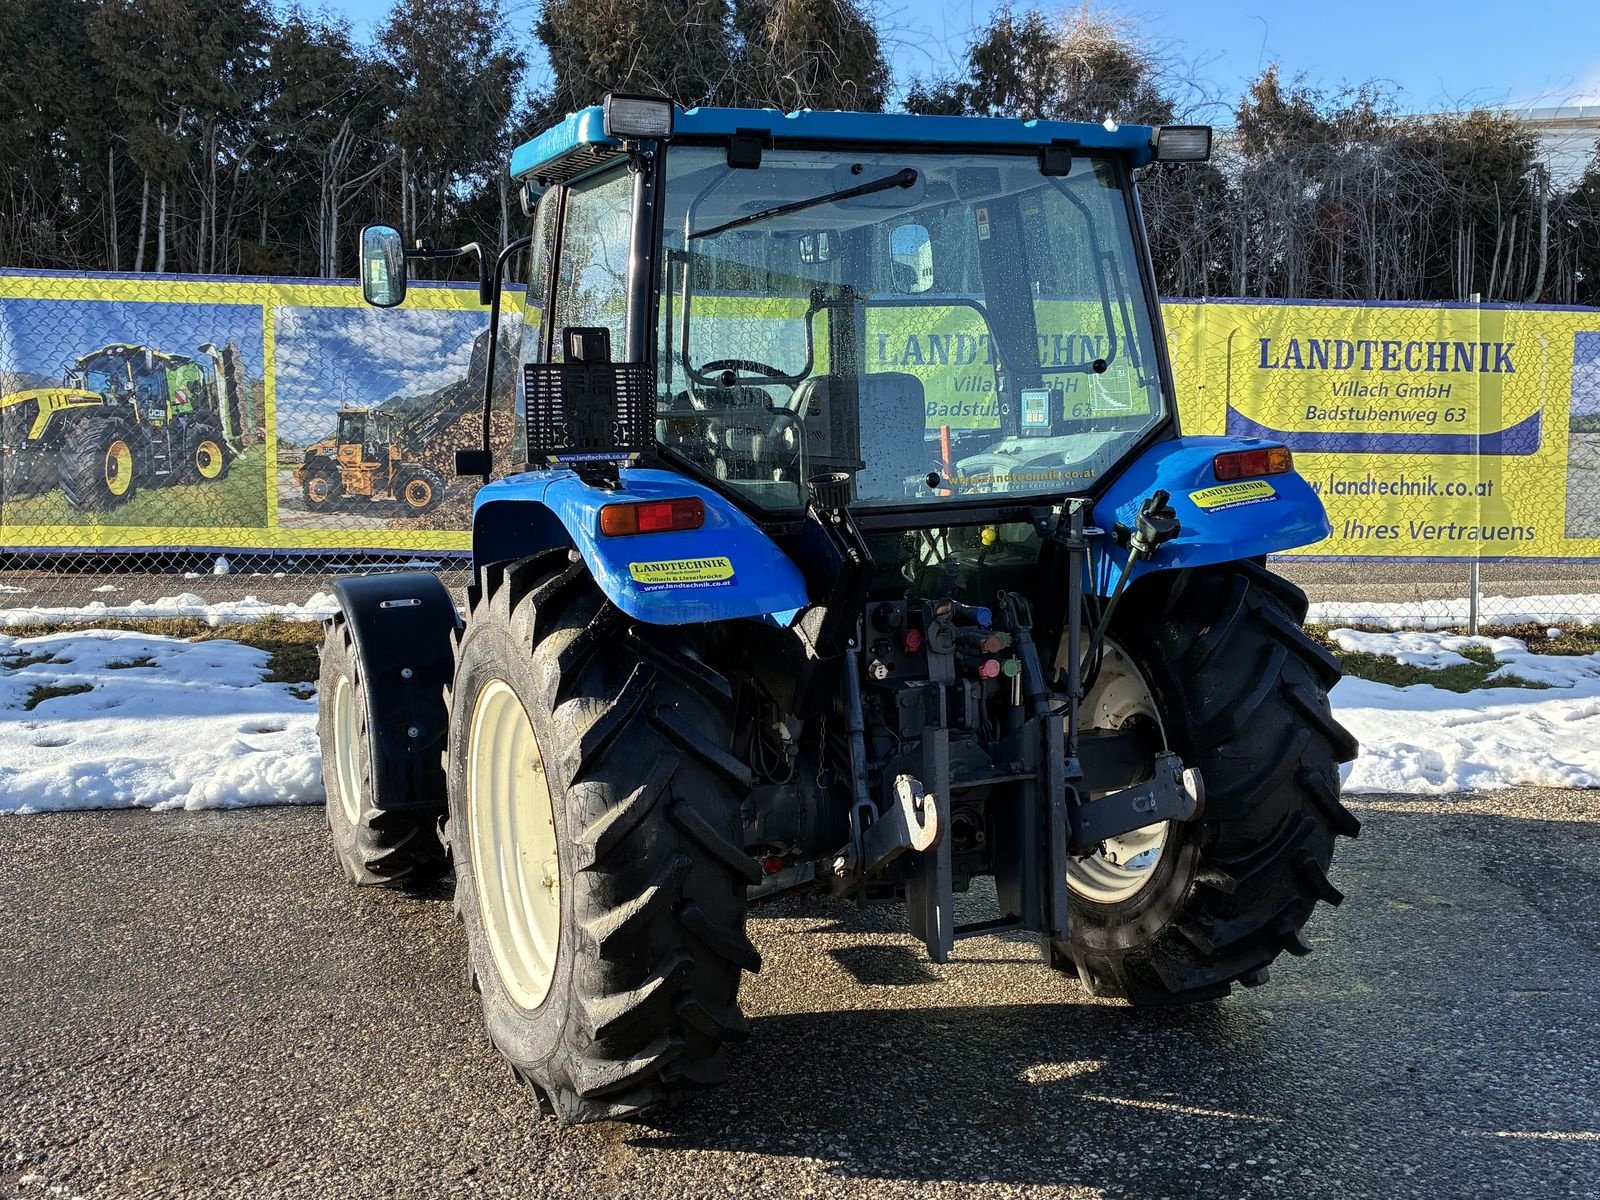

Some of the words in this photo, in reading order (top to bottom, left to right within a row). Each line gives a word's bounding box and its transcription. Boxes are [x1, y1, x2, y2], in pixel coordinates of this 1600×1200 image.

[1258, 338, 1516, 373] LANDTECHNIK
[1332, 382, 1389, 398] Villach
[1396, 383, 1452, 398] GmbH
[148, 408, 165, 417] JCB
[1305, 405, 1438, 425] Badstubenweg
[1444, 407, 1466, 422] 63
[560, 453, 628, 462] www.landtechnik.co.at
[1193, 481, 1267, 501] LANDTECHNIK
[1343, 519, 1400, 539] Ihres
[1409, 520, 1535, 541] Vertrauens
[634, 559, 727, 573] LANDTECHNIK
[643, 580, 731, 592] www.landtechnik.co.at
